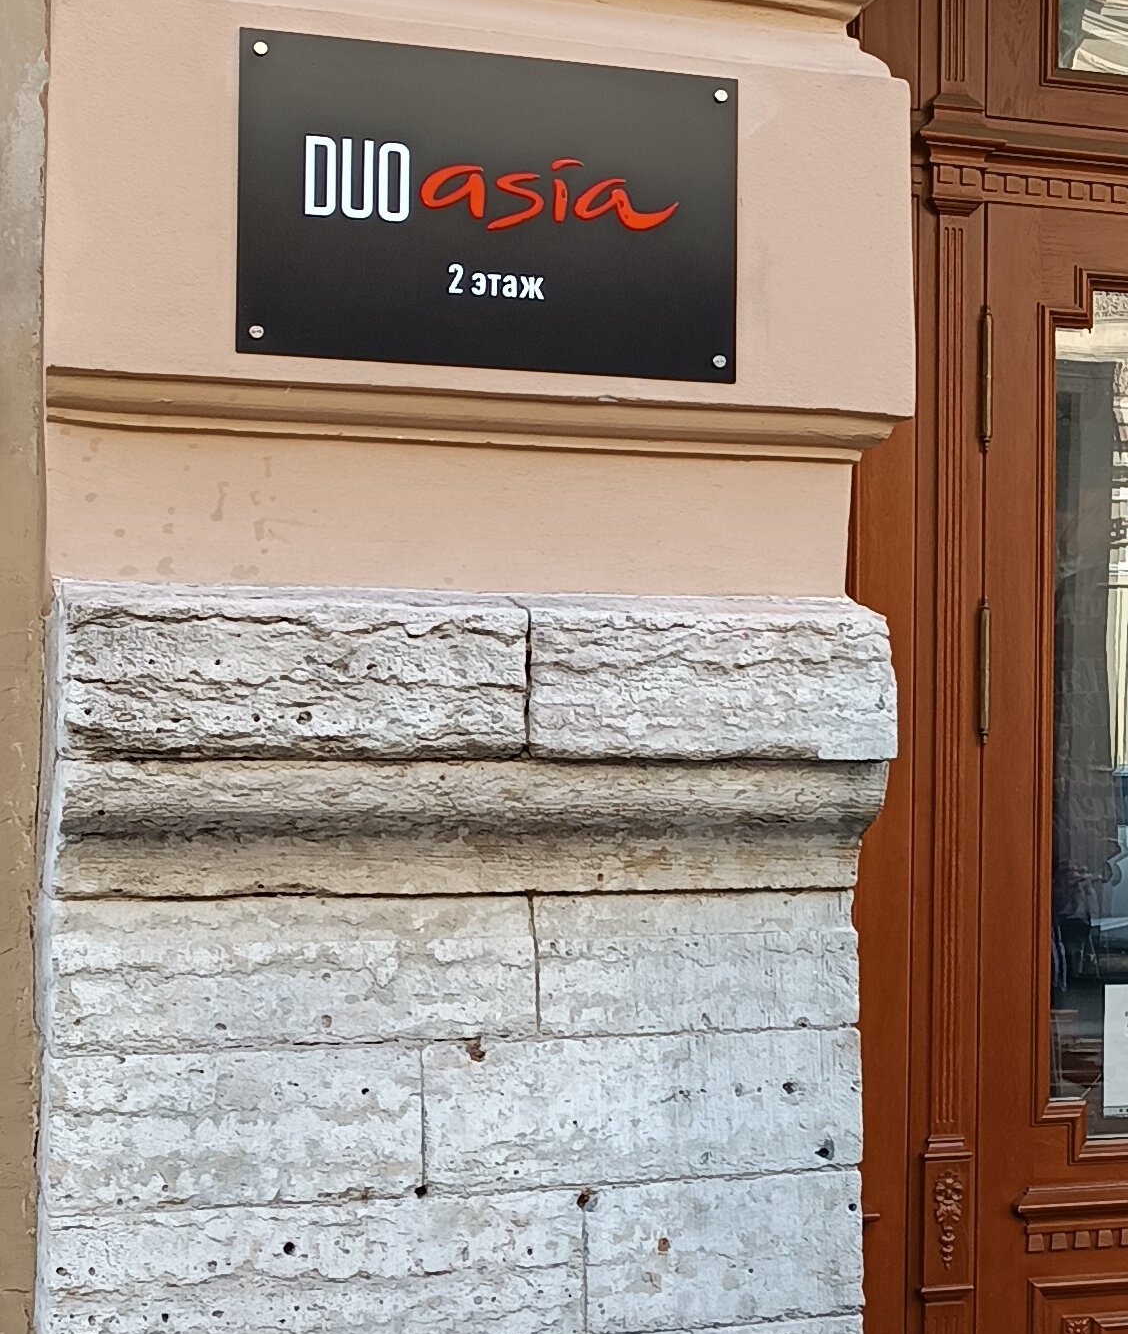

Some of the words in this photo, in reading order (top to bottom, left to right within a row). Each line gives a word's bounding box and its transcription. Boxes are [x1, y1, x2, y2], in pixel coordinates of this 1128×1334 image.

[304, 134, 411, 222] DUO
[448, 263, 464, 295] 2
[471, 270, 545, 300] этаж
